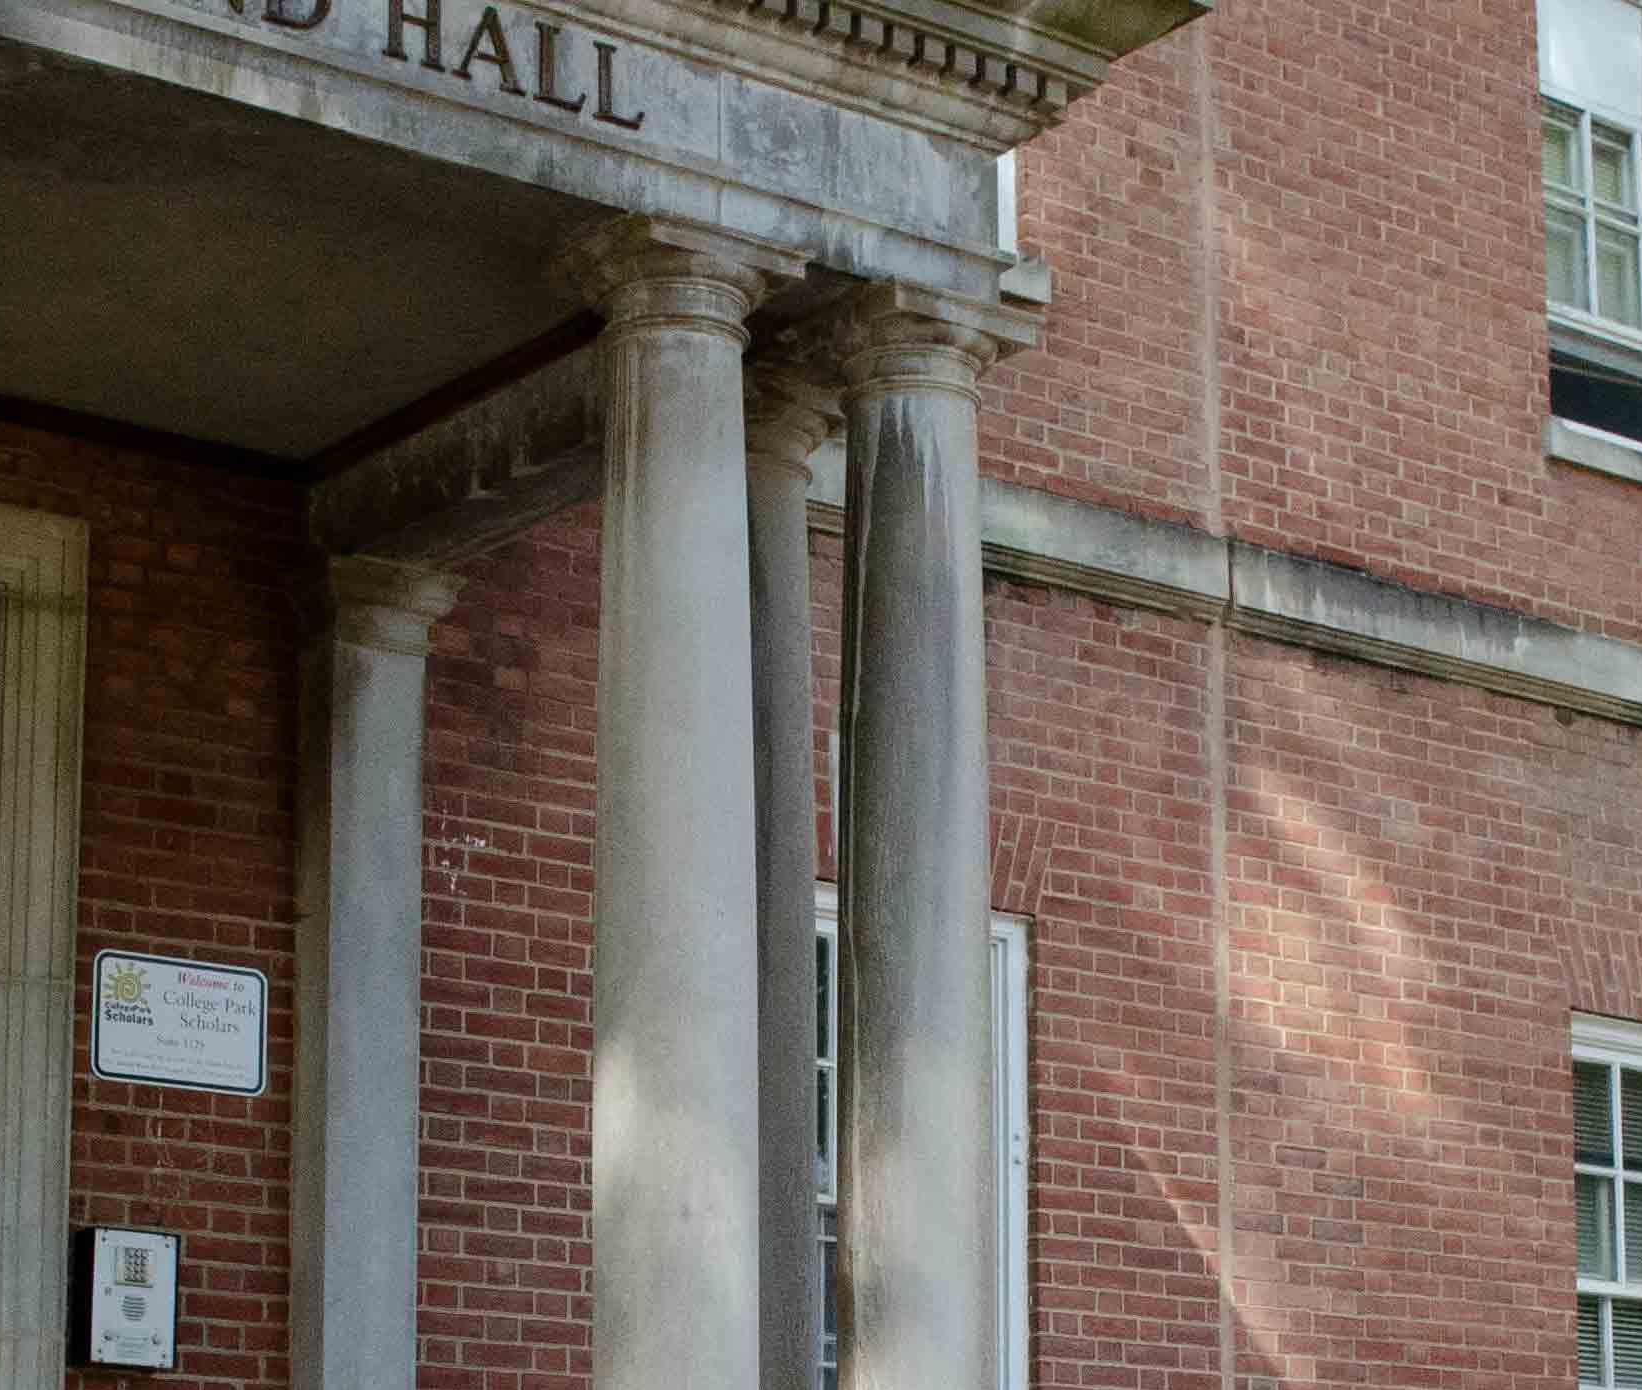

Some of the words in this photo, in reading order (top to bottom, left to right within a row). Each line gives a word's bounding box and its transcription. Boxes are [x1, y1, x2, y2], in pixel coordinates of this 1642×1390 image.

[381, 0, 645, 130] HALL
[178, 971, 230, 991] Welcome
[233, 981, 245, 993] to
[163, 991, 220, 1014] College
[224, 998, 256, 1016] Park
[103, 1009, 154, 1026] Scholars
[180, 1014, 240, 1033] Scholars
